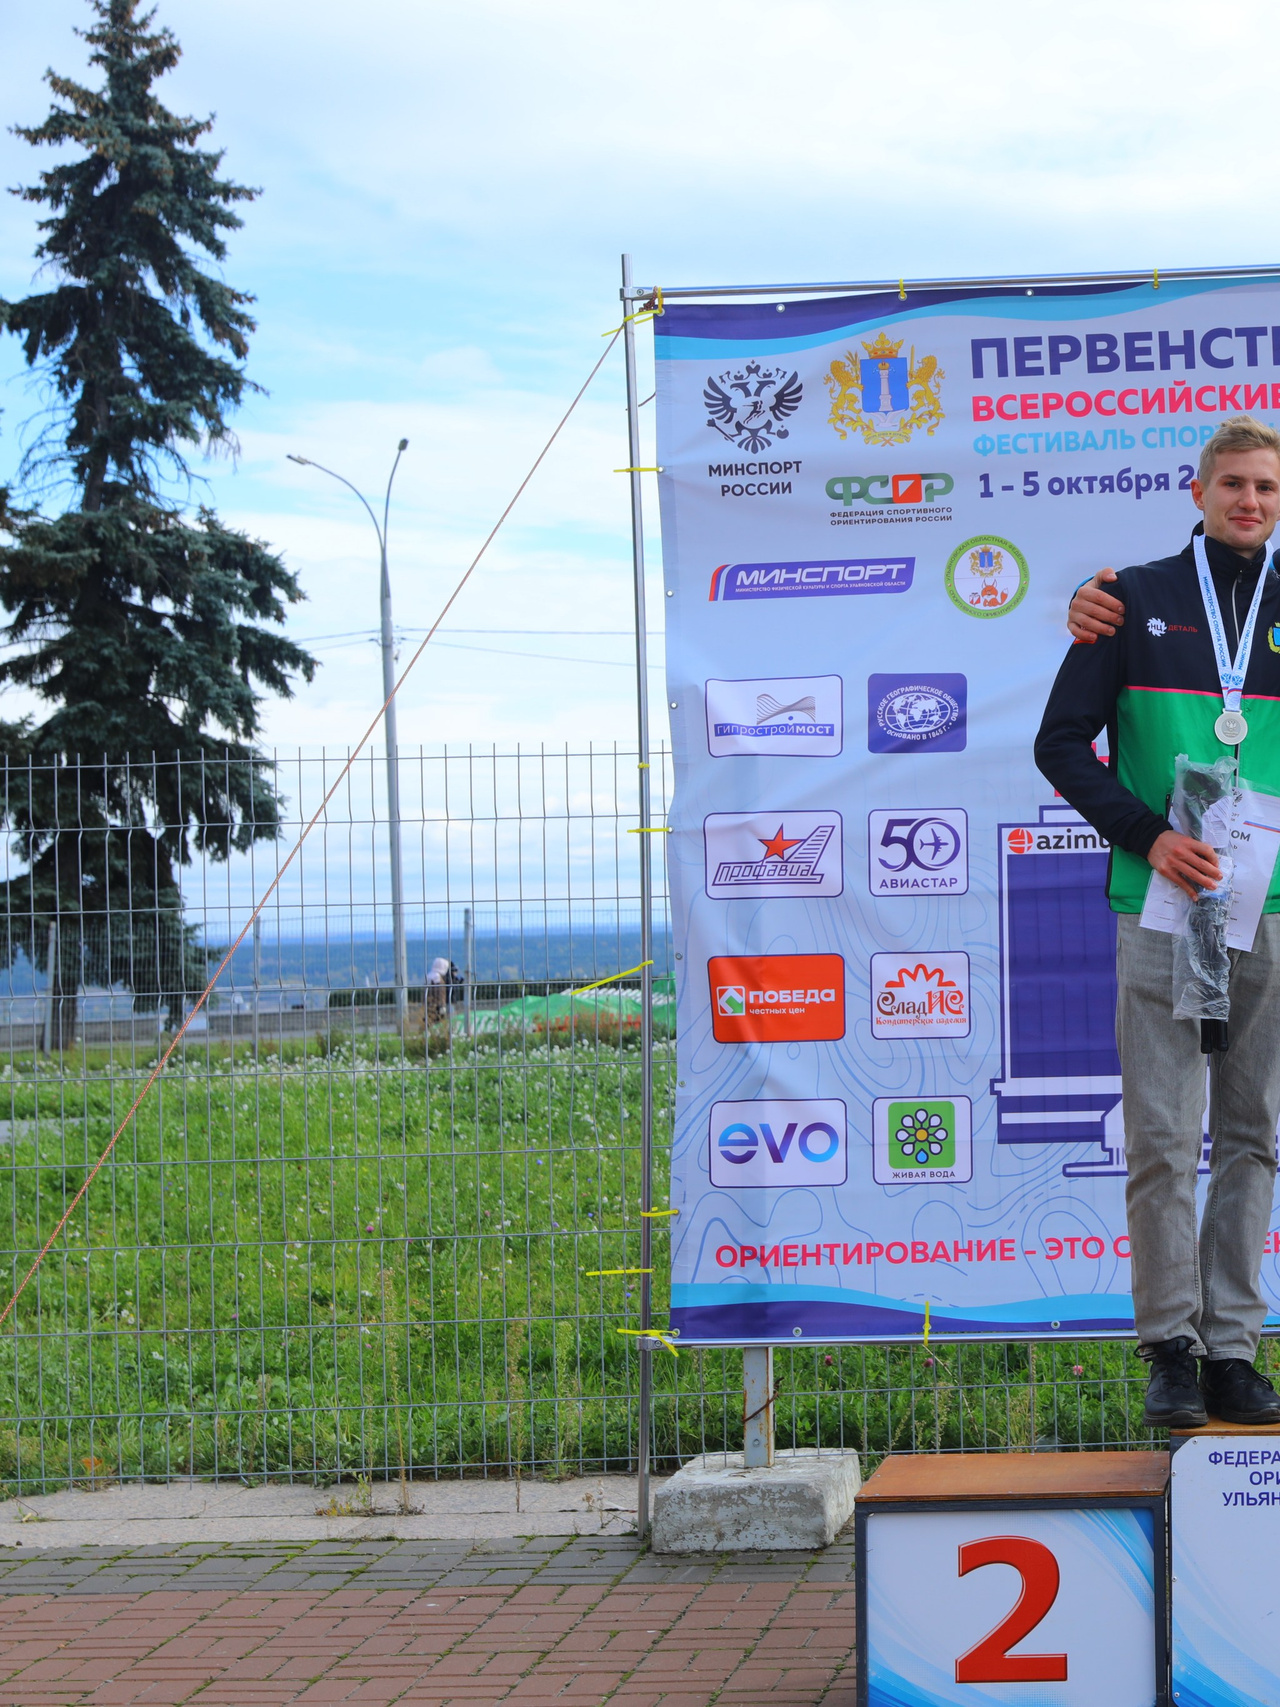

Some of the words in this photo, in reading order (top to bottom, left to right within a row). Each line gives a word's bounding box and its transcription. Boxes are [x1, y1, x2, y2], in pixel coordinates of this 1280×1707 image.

[973, 427, 1136, 457] ФЕСТИВАЛЬ
[708, 460, 803, 477] МИНСПОРТ
[720, 481, 793, 497] РОССИИ
[979, 473, 994, 498] 1
[1022, 470, 1041, 497] 5
[1047, 467, 1170, 500] октября
[829, 509, 885, 518] ФЕДЕРАЦИЯ
[886, 506, 953, 516] СПОРТИВНОГО
[830, 516, 913, 526] ОРИЕНТИРОВАНИЯ
[915, 515, 953, 523] РОССИИ
[736, 563, 906, 586] МИНСПОРТ
[1213, 620, 1223, 642] СПОРТА
[876, 699, 890, 727] РУССКОЕ
[886, 685, 943, 701] ГЕОГРАФИЧЕСКОЕ
[942, 693, 959, 722] ОБЩЕСТВО
[886, 729, 921, 740] ОСНОВАНО
[878, 818, 961, 871] 50
[1036, 828, 1111, 850] azimu
[879, 877, 958, 889] АВИАСТАР
[749, 1007, 786, 1015] честных
[788, 1006, 805, 1016] цен
[717, 1122, 840, 1164] evo
[929, 1171, 956, 1179] ВОДА
[715, 1238, 1016, 1268] ОРИЕНТИРОВАНИЕ
[1045, 1236, 1102, 1260] ЭТО
[955, 1535, 1068, 1684] 2
